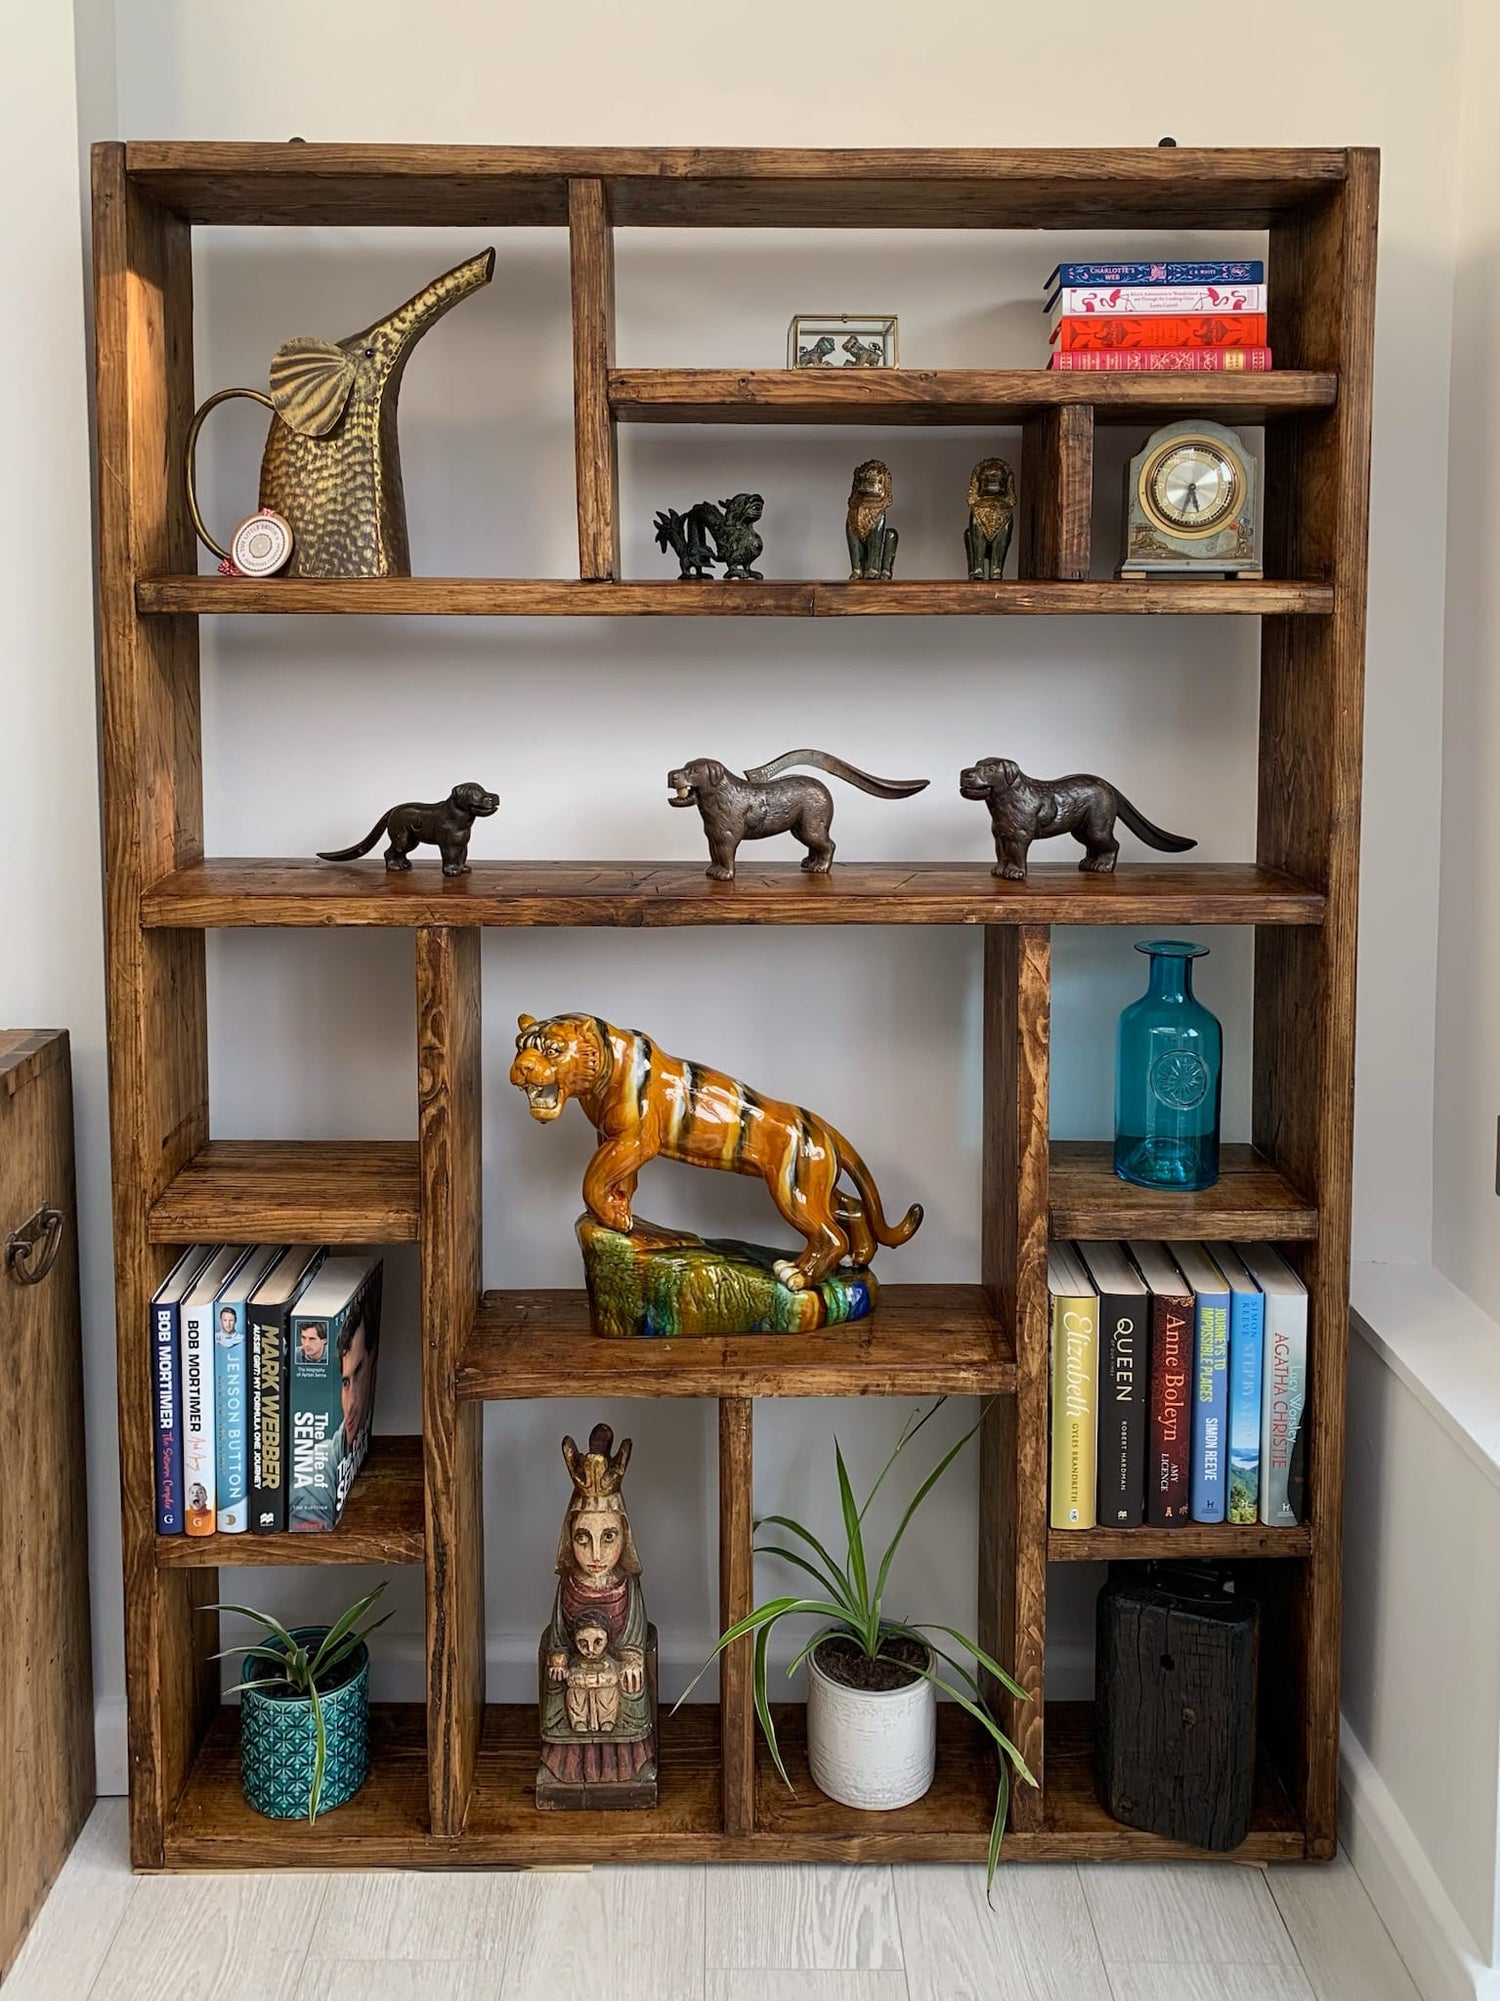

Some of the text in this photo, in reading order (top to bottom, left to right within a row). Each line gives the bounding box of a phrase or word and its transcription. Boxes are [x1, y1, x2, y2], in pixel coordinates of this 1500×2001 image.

[253, 1323, 261, 1354] AUSSIE
[1214, 1308, 1227, 1371] JOURNEYS TO
[1241, 1302, 1250, 1336] REEVE
[1250, 1301, 1258, 1338] SIMON
[158, 1310, 173, 1429] BOB MORTIMER
[188, 1320, 201, 1432] BOB MORTIMER
[253, 1376, 261, 1390] MY
[1063, 1311, 1093, 1418] Elizabeth
[1113, 1318, 1134, 1401] QUEEN
[1158, 1314, 1186, 1441] Anne Boleyn
[1200, 1307, 1214, 1403] IMPOSSIBLE PLACES
[227, 1353, 242, 1498] JENSON BUTTON
[253, 1391, 261, 1430] FORMULA
[261, 1324, 280, 1489] MARK WEBBER
[1271, 1333, 1289, 1468] AGATHA CHRISTIE
[1287, 1365, 1304, 1443] Lucy Worsley
[162, 1431, 174, 1447] The
[253, 1432, 261, 1450] ONE
[294, 1411, 314, 1489] SENNA
[314, 1412, 329, 1488] The Life of
[1071, 1423, 1079, 1448] GYLES
[1204, 1417, 1218, 1481] SIMON REEVE
[254, 1450, 262, 1489] JOURNEY
[1160, 1453, 1170, 1492] LICENCE
[1170, 1463, 1179, 1483] AMY
[163, 1514, 173, 1524] G
[192, 1517, 202, 1527] G
